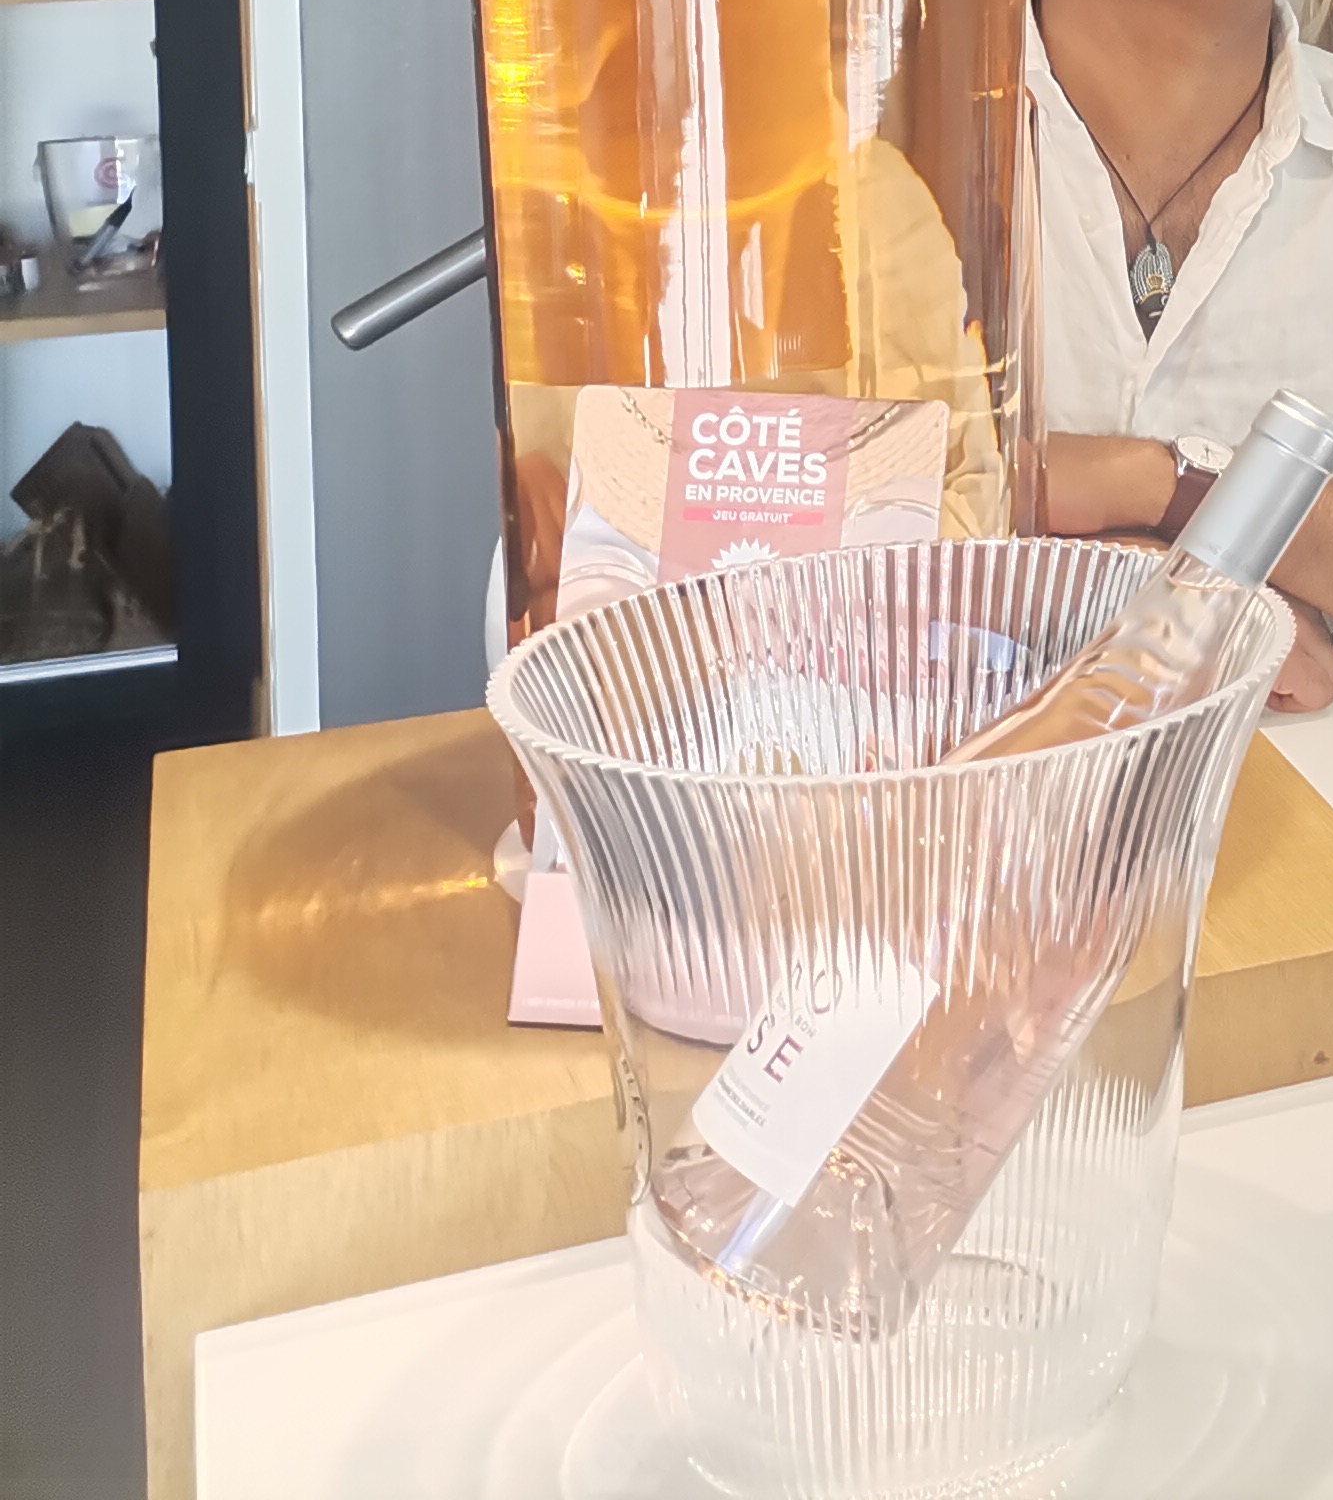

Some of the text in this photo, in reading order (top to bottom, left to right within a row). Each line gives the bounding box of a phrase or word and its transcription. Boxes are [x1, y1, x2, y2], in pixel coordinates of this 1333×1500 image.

[691, 406, 802, 449] CÔTÉ
[687, 450, 828, 485] CAVES
[685, 483, 826, 506] EN PROVENCE
[712, 508, 737, 523] JEU
